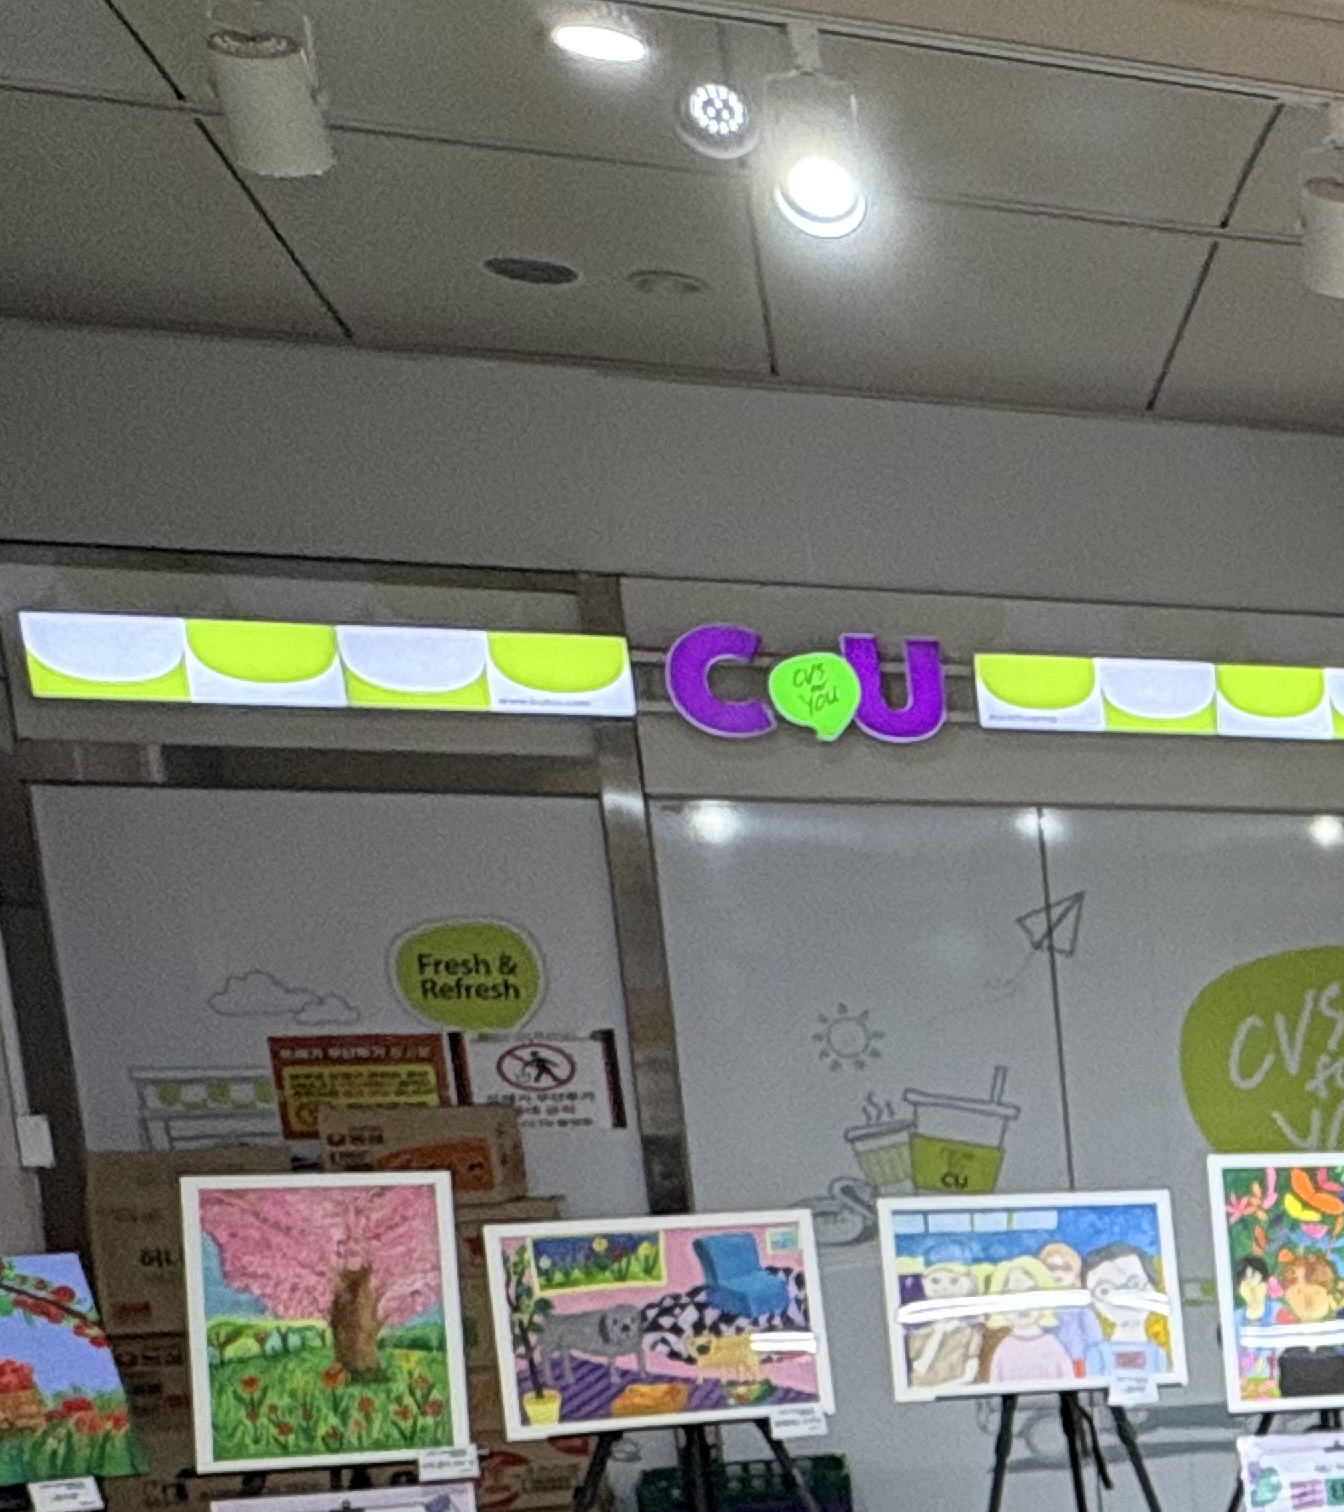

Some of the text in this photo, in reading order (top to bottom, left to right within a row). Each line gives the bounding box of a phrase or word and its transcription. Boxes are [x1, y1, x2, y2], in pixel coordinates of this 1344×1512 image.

[664, 622, 948, 744] CU
[792, 662, 826, 688] CVS
[417, 952, 518, 976] Fresh &
[420, 976, 521, 1000] Refresh
[940, 1171, 968, 1190] CU
